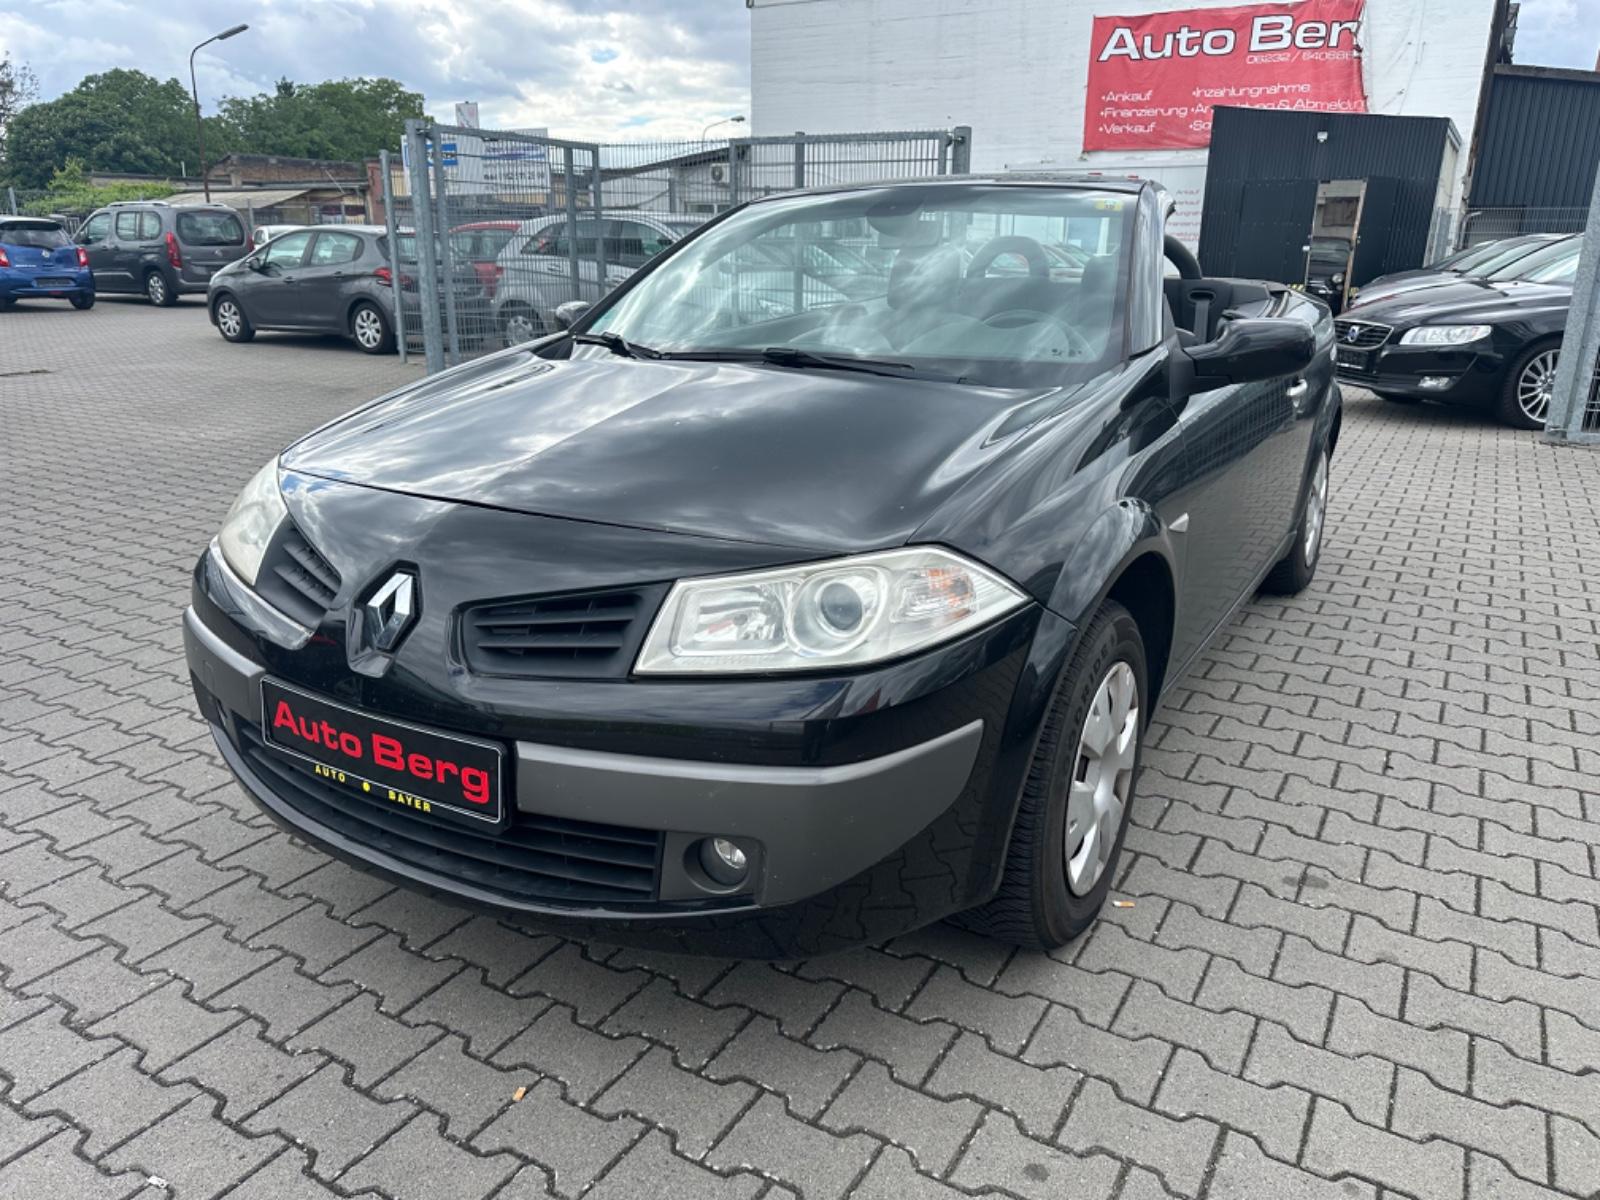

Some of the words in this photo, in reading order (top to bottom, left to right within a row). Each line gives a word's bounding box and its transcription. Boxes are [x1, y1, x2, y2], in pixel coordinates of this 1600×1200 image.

[1097, 25, 1237, 62] Auto
[1250, 14, 1361, 52] Ber
[1107, 91, 1153, 102] Ankauf
[1196, 83, 1310, 97] Inzahlungnahme
[1105, 107, 1188, 119] Finanzierung
[1103, 122, 1156, 134] Verkauf
[274, 701, 363, 758] Auto
[372, 733, 490, 804] Berg
[315, 765, 346, 783] AUTO
[388, 790, 432, 813] BAYER
